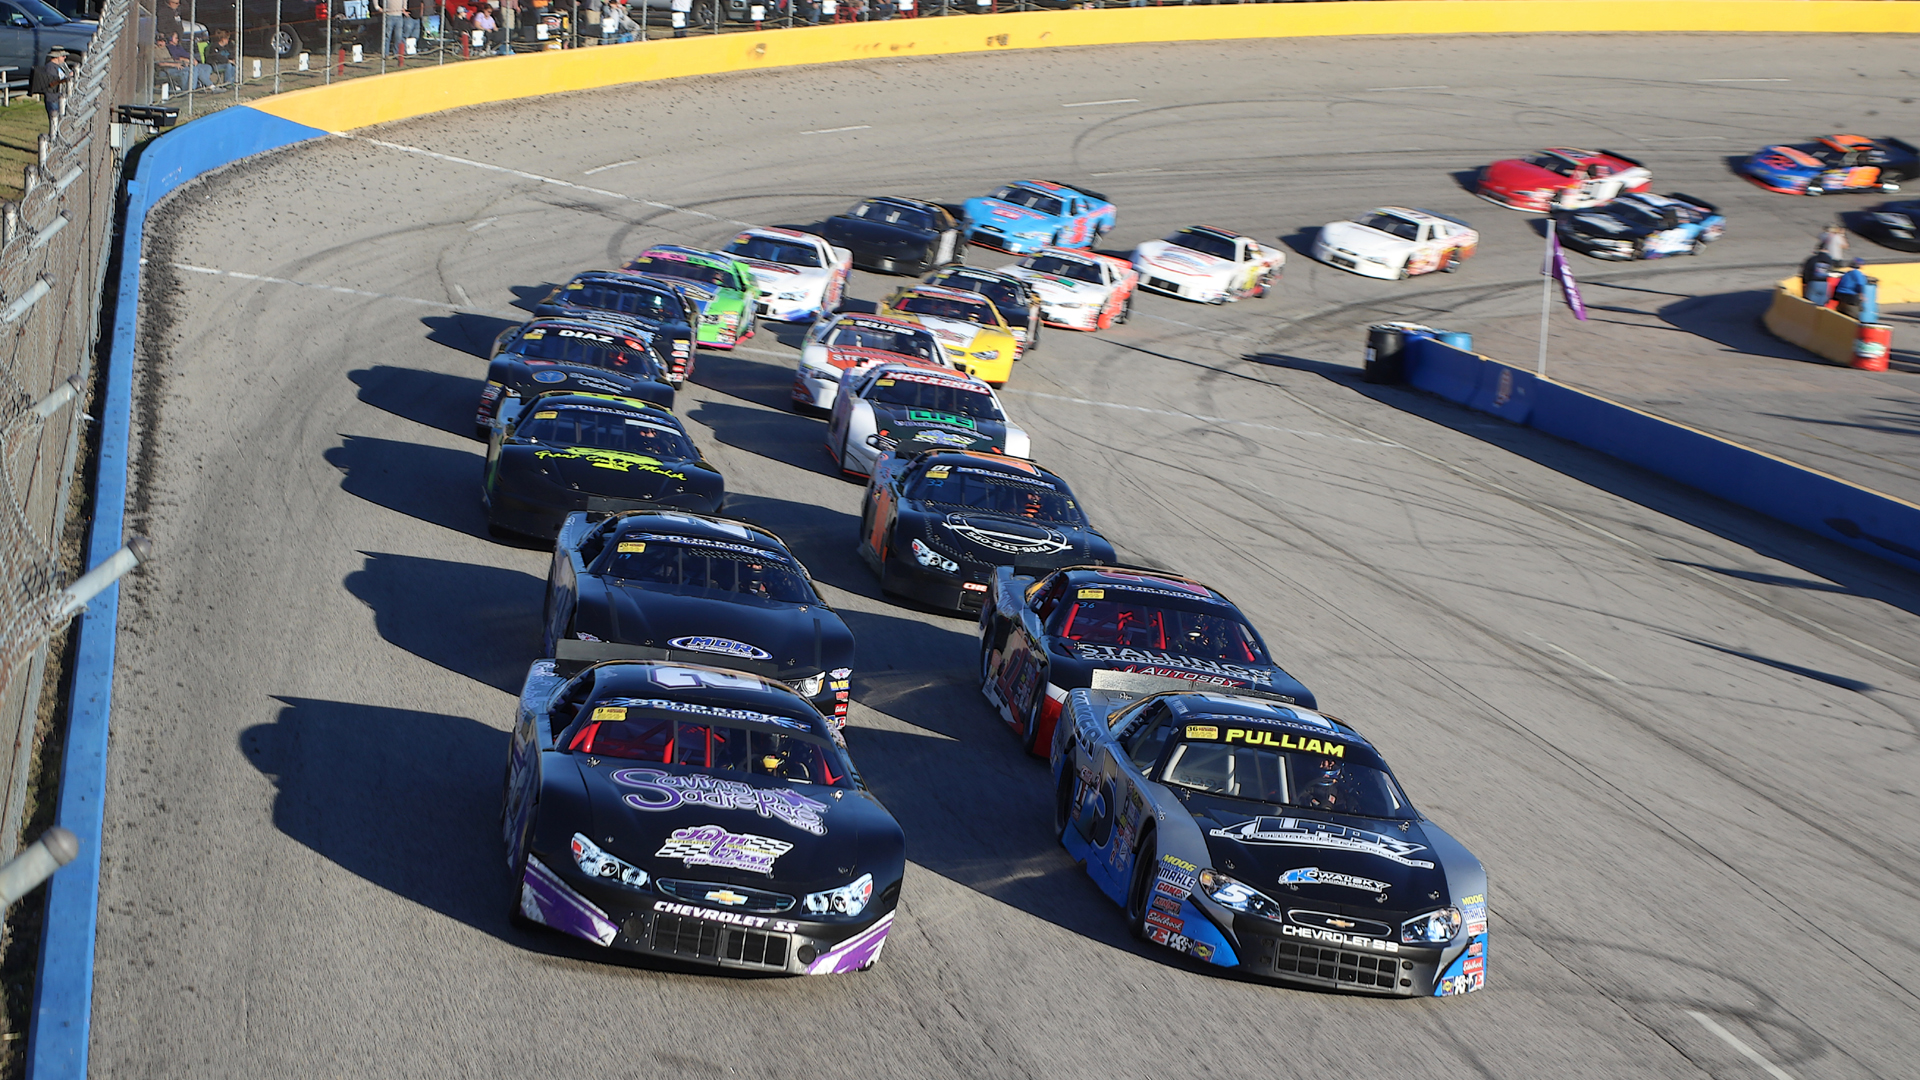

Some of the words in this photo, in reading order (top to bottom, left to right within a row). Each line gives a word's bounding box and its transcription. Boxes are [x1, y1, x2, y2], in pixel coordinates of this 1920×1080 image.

[558, 329, 615, 344] DIAZ
[966, 531, 1053, 553] 540-943-9844
[690, 637, 753, 653] MDR
[1081, 643, 1271, 681] STALLINGS
[629, 698, 711, 713] SOLID
[712, 706, 781, 725] ROCK
[1225, 728, 1345, 758] PULLIAM
[1162, 854, 1198, 872] MOOG
[1160, 867, 1197, 888] MAHLE
[1288, 868, 1384, 889] KOWALSKY
[1158, 882, 1183, 898] COMP
[1213, 882, 1259, 905] 5
[1461, 893, 1485, 906] MOOG
[653, 901, 770, 927] CHEVROLET
[773, 921, 799, 933] SS
[1147, 911, 1184, 931] Edelbrock
[1281, 923, 1370, 948] CHEVROLET
[1371, 937, 1400, 952] SS
